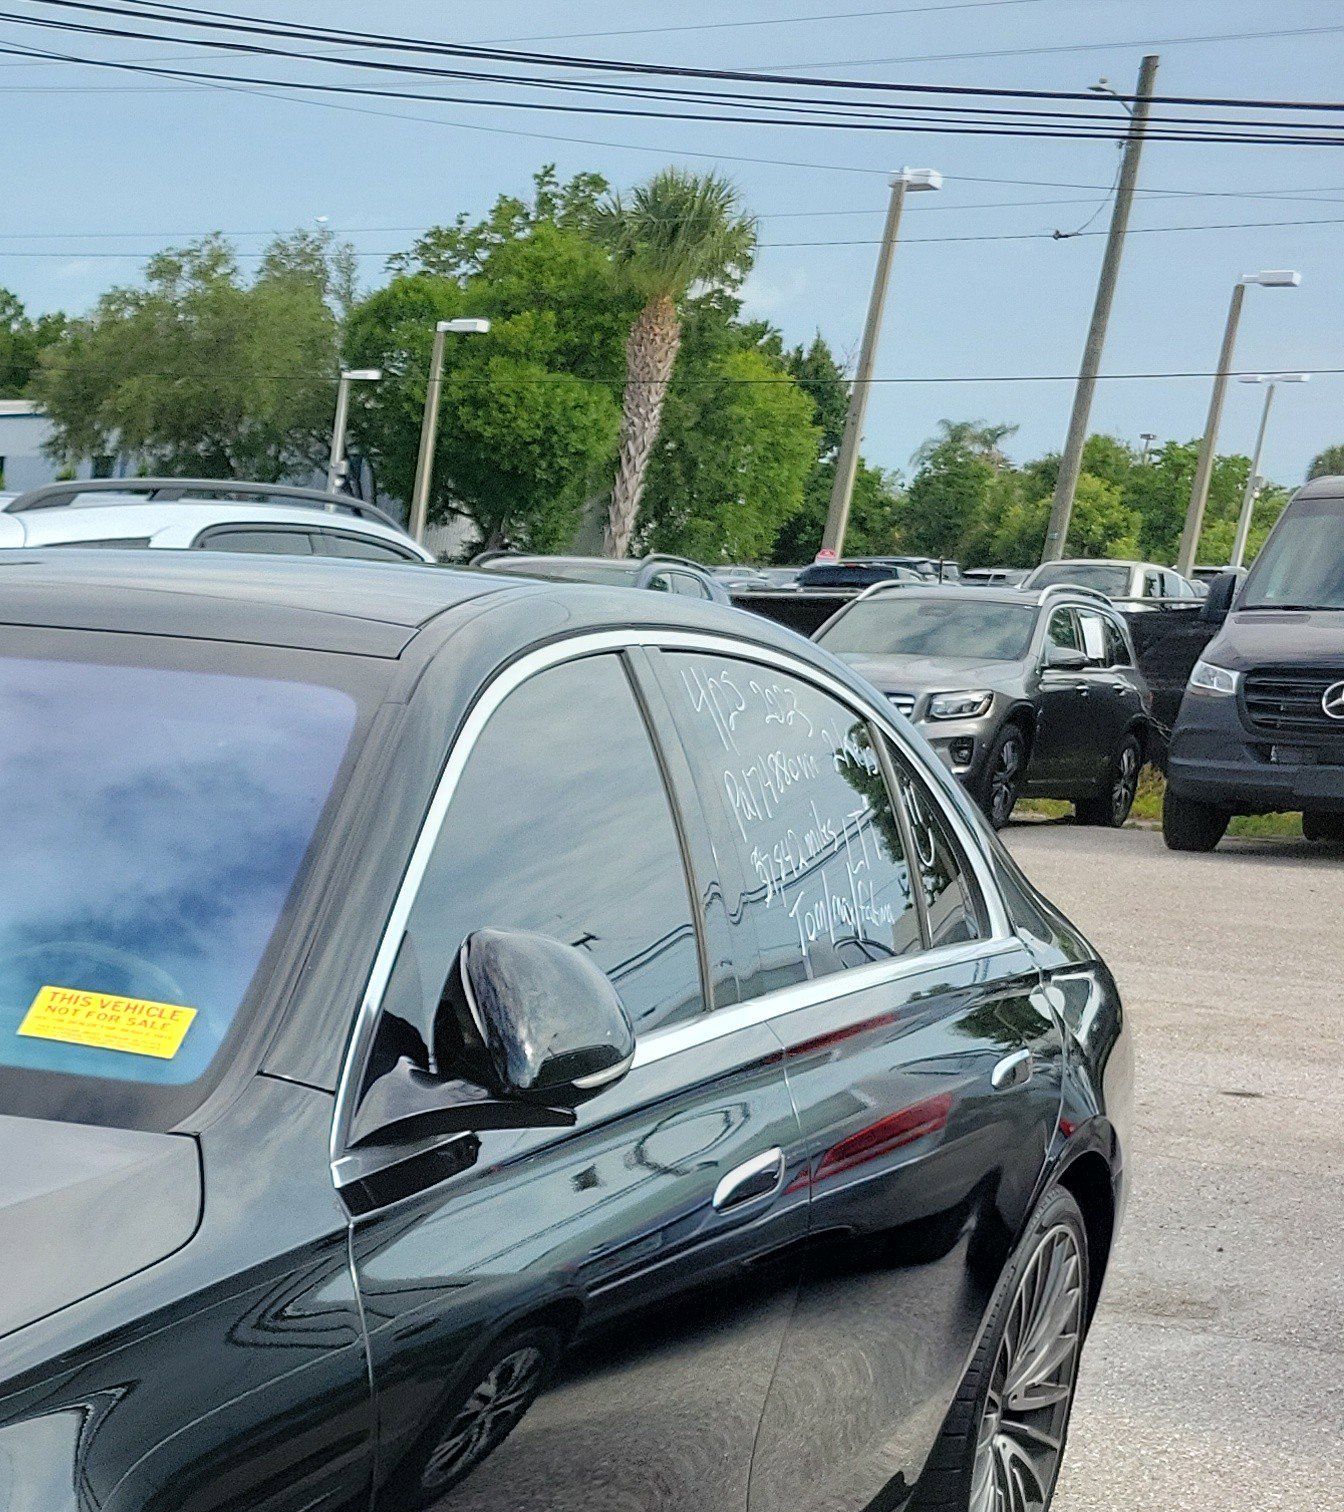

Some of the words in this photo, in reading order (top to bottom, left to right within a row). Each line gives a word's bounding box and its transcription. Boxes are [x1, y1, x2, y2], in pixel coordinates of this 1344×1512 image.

[45, 1005, 83, 1018] NOT
[85, 1010, 121, 1024] FOR
[127, 1017, 172, 1032] SALE
[48, 991, 93, 1008] THIS
[99, 998, 183, 1022] VEHICLE
